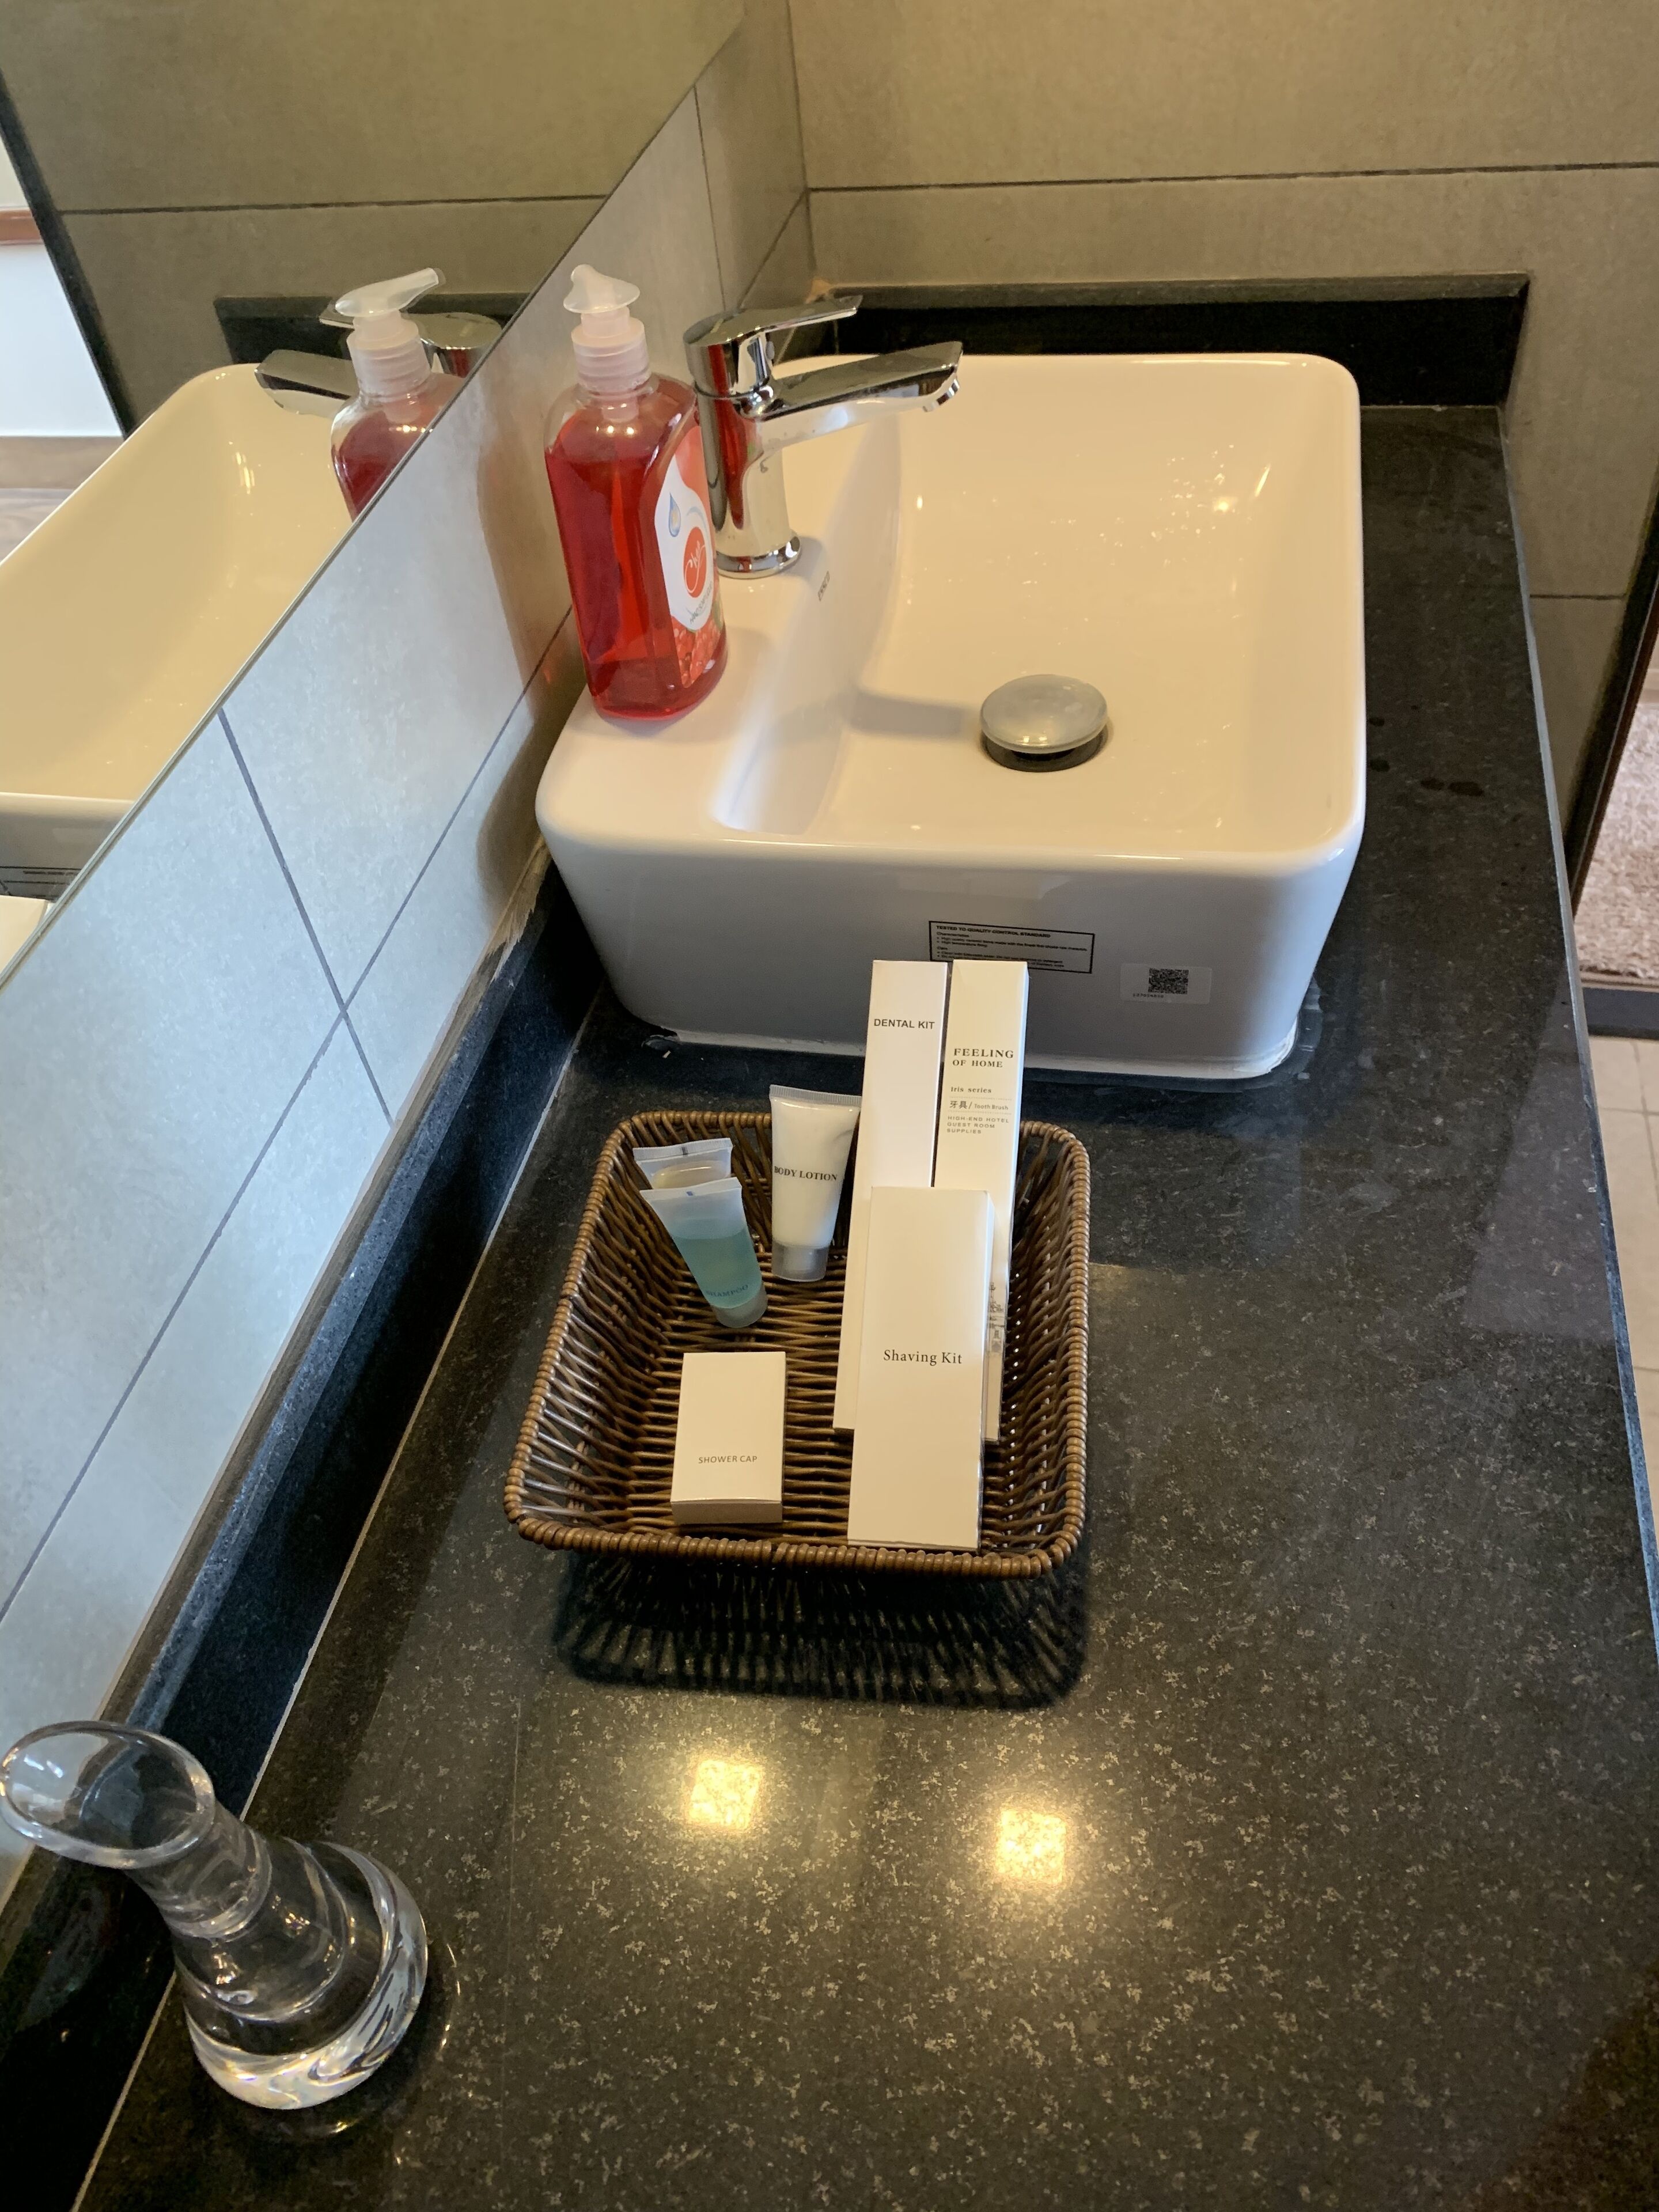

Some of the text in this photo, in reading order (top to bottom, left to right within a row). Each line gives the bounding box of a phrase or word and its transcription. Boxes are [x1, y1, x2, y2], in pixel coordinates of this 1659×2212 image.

[874, 1018, 935, 1029] DENTAL KIT
[954, 1048, 1014, 1059] FEELING
[972, 1060, 1003, 1068] HOME
[774, 1166, 838, 1181] BODY LOTION
[706, 1285, 748, 1297] SHAMPOO
[883, 1349, 963, 1366] Shaving Kit
[698, 1455, 738, 1464] SHOWER
